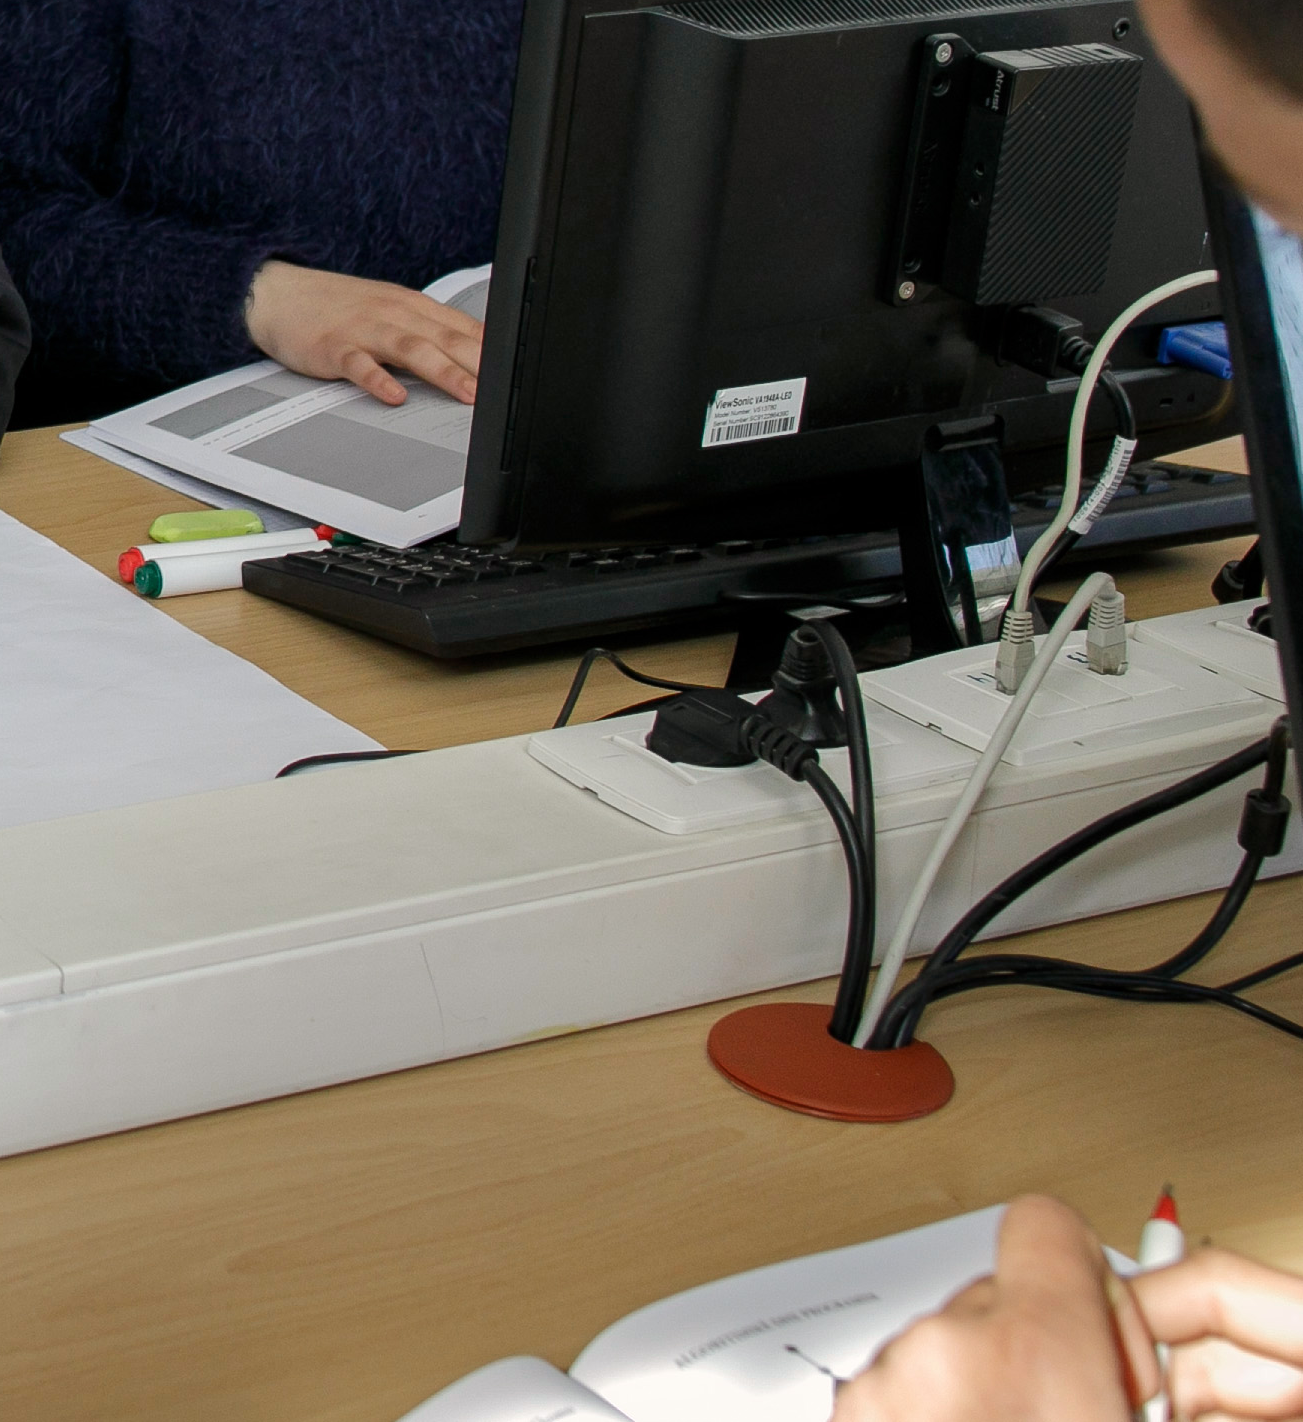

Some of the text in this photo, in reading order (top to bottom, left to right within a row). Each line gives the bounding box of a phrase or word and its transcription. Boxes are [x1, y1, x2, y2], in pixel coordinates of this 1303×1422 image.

[991, 68, 1005, 111] Atrust
[715, 395, 753, 409] ViewSonic
[730, 408, 751, 416] Number
[728, 416, 748, 425] Number
